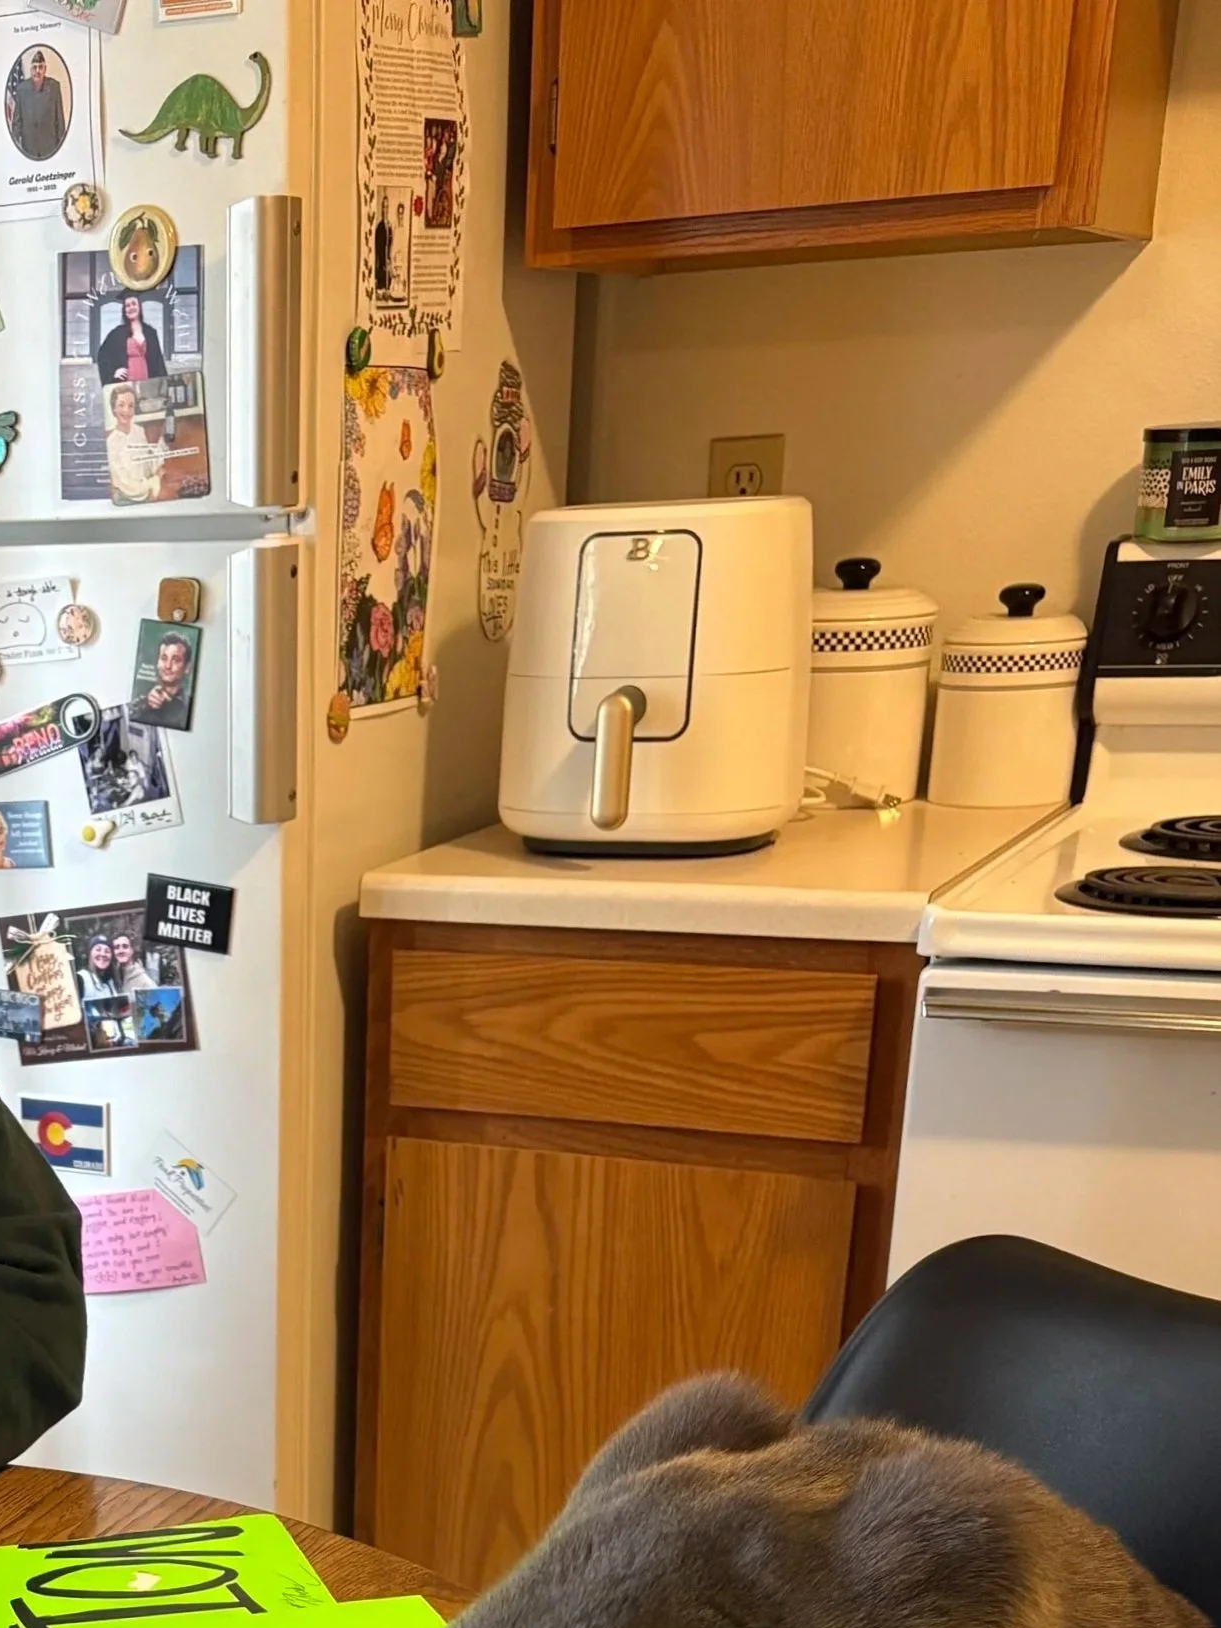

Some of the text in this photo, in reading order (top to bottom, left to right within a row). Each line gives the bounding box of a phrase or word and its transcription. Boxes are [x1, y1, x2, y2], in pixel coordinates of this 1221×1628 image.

[1182, 465, 1214, 481] EMILY
[1184, 479, 1217, 496] PARIS
[166, 884, 211, 907] BLACK
[167, 903, 206, 924] LIVES
[157, 921, 213, 946] MATTER
